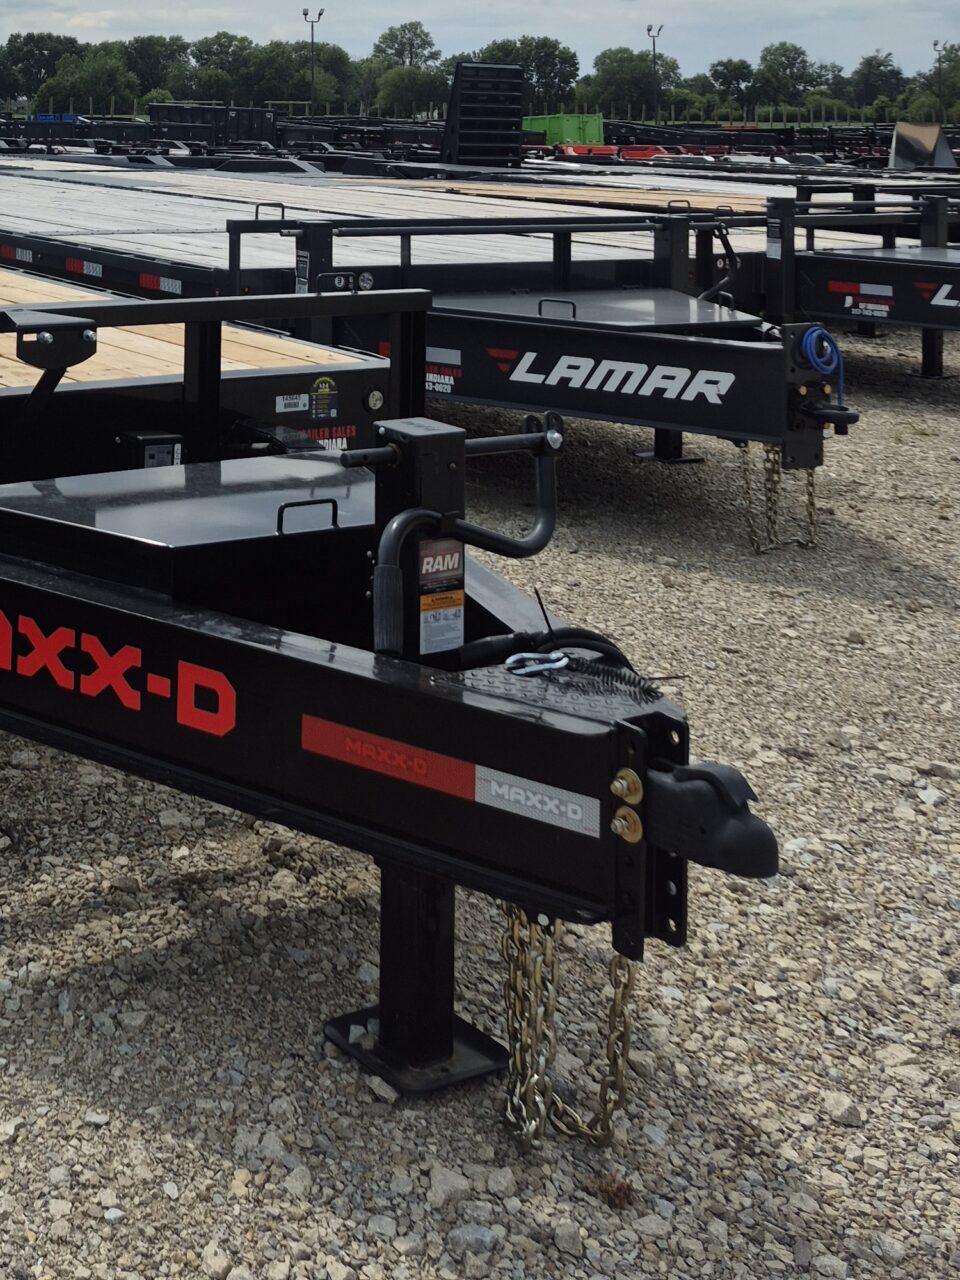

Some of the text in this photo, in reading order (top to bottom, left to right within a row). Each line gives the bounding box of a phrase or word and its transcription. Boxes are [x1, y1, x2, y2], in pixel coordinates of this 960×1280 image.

[509, 352, 736, 405] LAMAR
[332, 425, 357, 439] SALES
[422, 552, 460, 574] RAM
[345, 736, 428, 774] MAXX-D
[490, 780, 583, 821] MAXX-D
